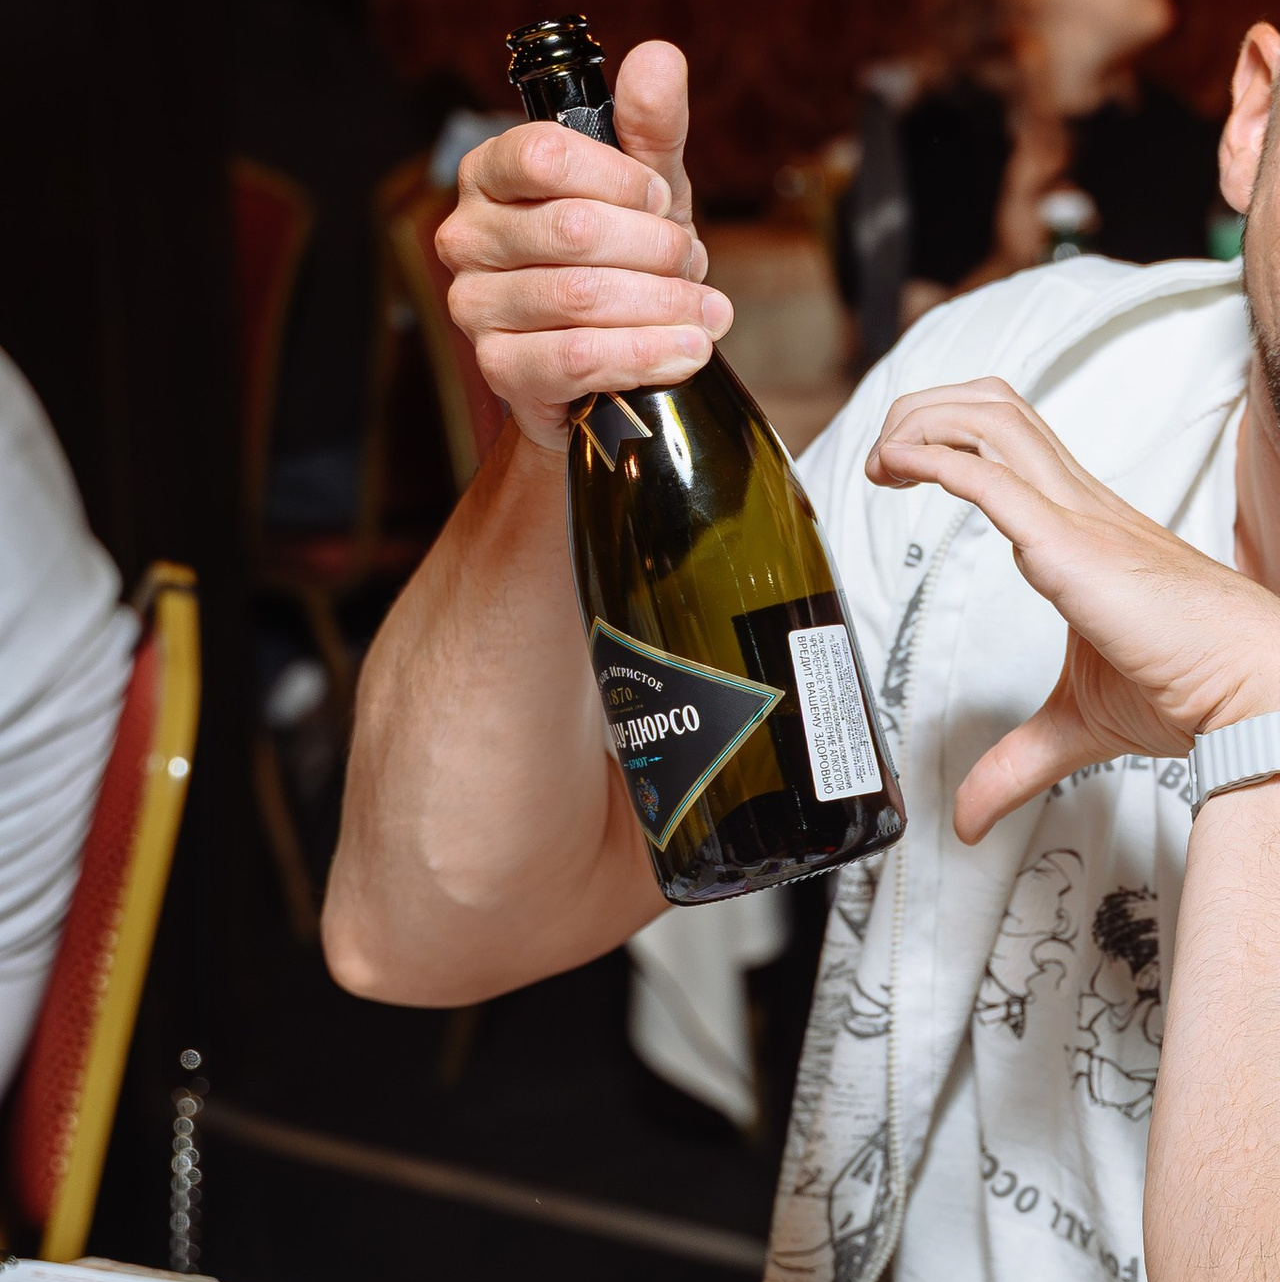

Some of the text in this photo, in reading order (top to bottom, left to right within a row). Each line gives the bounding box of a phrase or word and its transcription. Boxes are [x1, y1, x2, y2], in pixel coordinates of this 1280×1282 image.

[794, 635, 835, 795] ВРЕДИТ ВАШЕМУ ЗДОРОВЬЮ
[806, 633, 846, 792] ЧРЕЗМЕРНОЕ УПОТРЕБЛЕНИЕ АЛКОГОЛЯ
